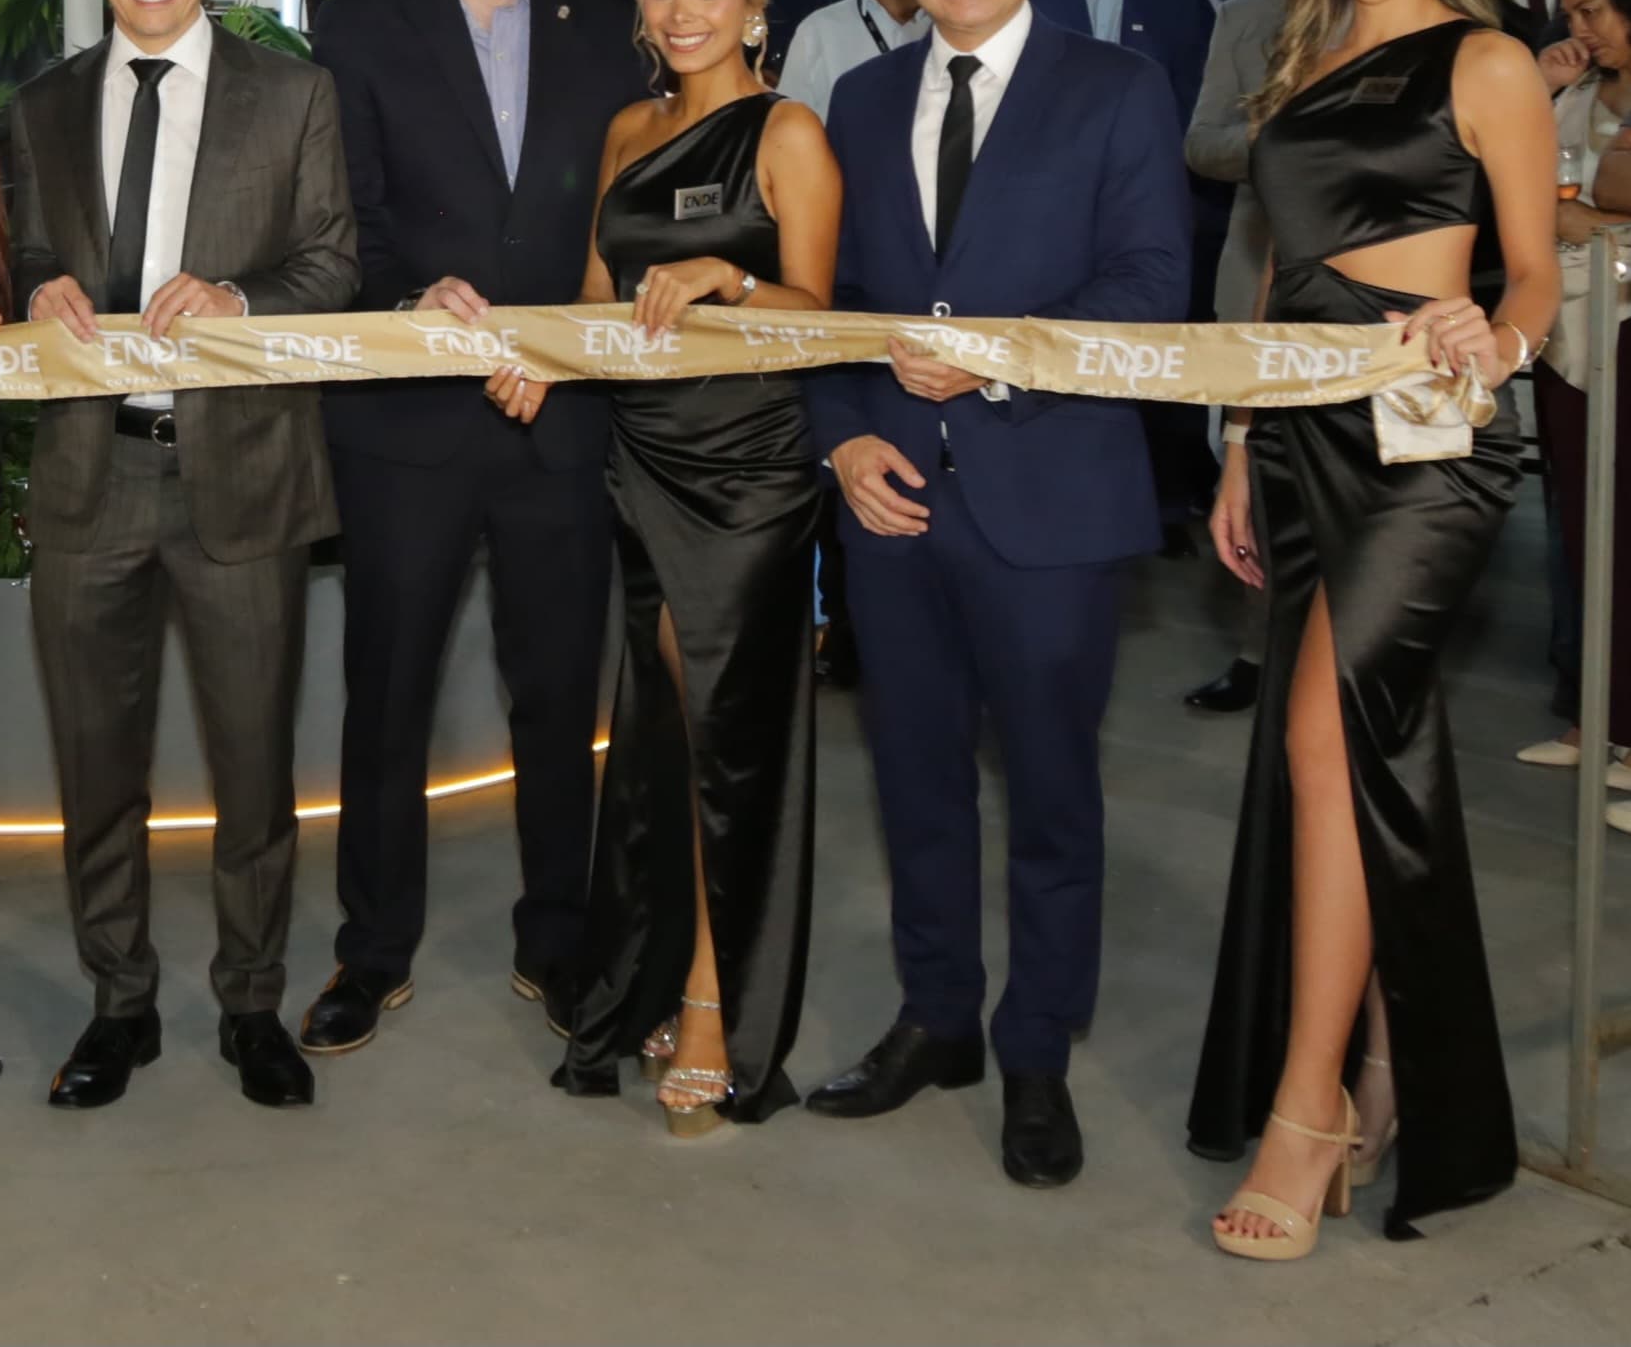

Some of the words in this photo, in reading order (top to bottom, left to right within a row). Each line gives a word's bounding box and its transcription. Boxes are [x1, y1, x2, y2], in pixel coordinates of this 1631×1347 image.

[103, 336, 199, 367] ENDE
[263, 335, 363, 363] ENDE
[425, 327, 521, 359] ENDE
[1076, 343, 1186, 380] ENDE
